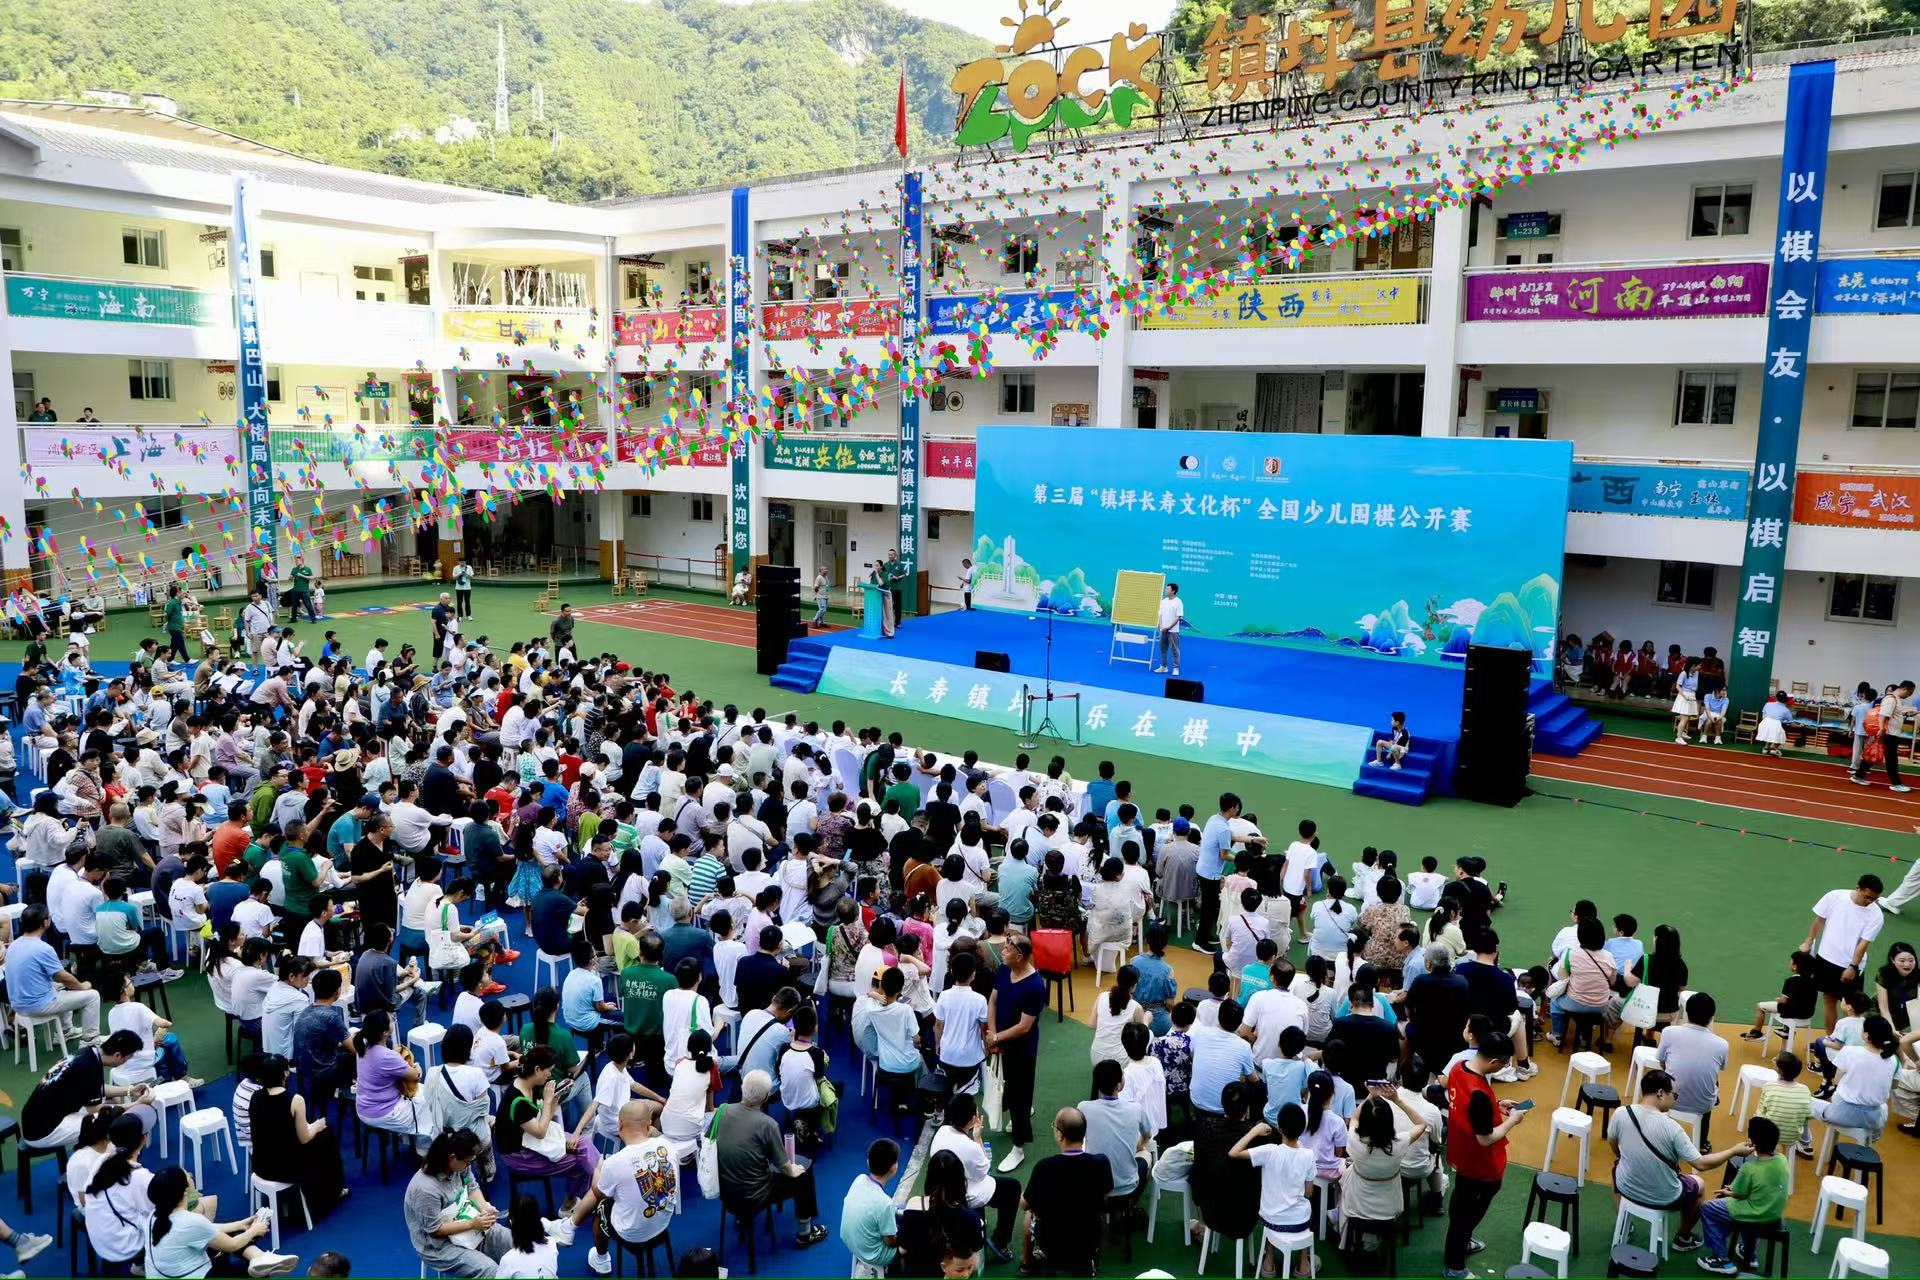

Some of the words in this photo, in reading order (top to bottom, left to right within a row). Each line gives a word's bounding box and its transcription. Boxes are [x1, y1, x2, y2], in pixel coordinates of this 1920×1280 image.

[1200, 0, 1738, 101] 镇坪县幼儿园
[1201, 92, 1332, 128] ZHENPING
[1338, 76, 1463, 112] COUNTY
[1471, 40, 1744, 96] KINDERGARTEN
[21, 286, 49, 301] 万宁
[97, 290, 156, 320] 海南
[1237, 288, 1306, 322] 陕西
[1529, 293, 1559, 307] 洛阳
[1566, 274, 1656, 314] 河南
[1656, 293, 1711, 309] 平顶山
[902, 248, 918, 409] 黑白纵横承粹
[732, 369, 748, 463] 长寿坪
[1738, 171, 1819, 659] 以棋会友·以棋启智
[47, 445, 99, 456] 浦新区
[111, 432, 166, 463] 上海
[812, 442, 857, 471] 安徽
[940, 455, 974, 468] 和平区
[247, 402, 273, 546] 大格局向未
[1653, 479, 1682, 498] 南宁
[900, 422, 916, 577] 山水镇坪育棋才
[1033, 482, 1473, 534] 第三届“镇坪长寿文化杯”全国少儿围棋公开赛
[1689, 490, 1720, 506] 玉林
[1814, 490, 1856, 515] 咸宁
[1869, 488, 1911, 512] 武汉
[733, 482, 748, 549] 欢迎您
[1084, 703, 1263, 758] 乐在棋中
